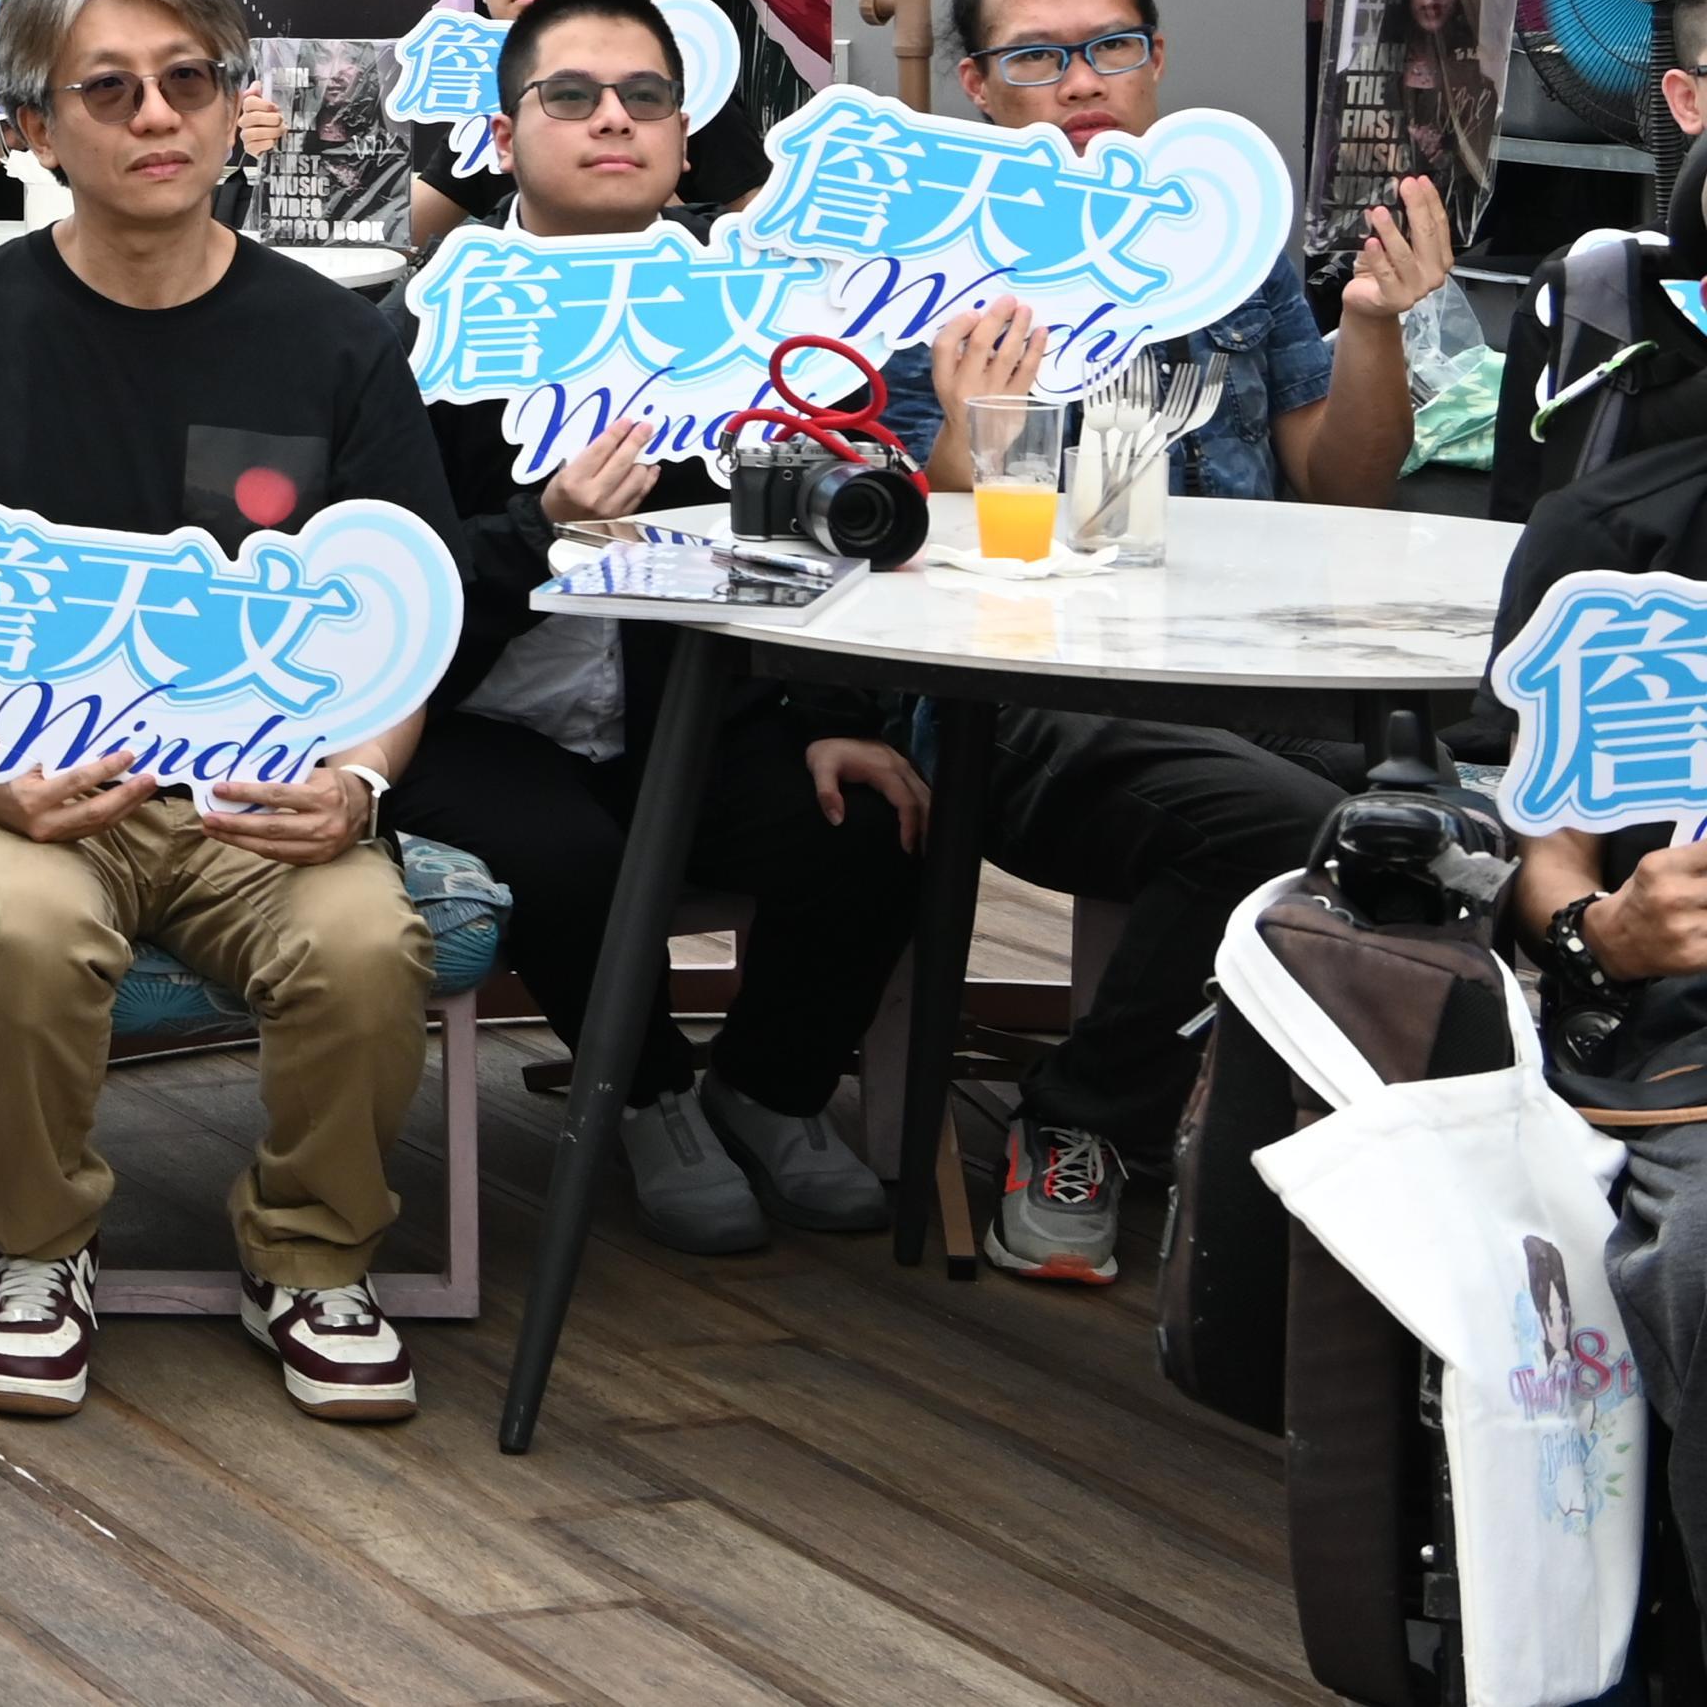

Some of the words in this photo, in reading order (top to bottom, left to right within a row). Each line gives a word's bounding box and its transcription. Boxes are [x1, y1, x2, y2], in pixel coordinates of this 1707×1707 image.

[1346, 76, 1386, 106] THE
[1341, 109, 1404, 140] FIRST
[270, 154, 321, 174] FIRST
[1337, 143, 1411, 174] MUSIC
[269, 176, 331, 196] MUSIC
[767, 102, 1193, 298] 詹天文
[269, 197, 323, 218] VIDEO
[268, 219, 330, 240] PHOTO
[333, 220, 385, 241] BOOK
[425, 239, 822, 388] 詹天文
